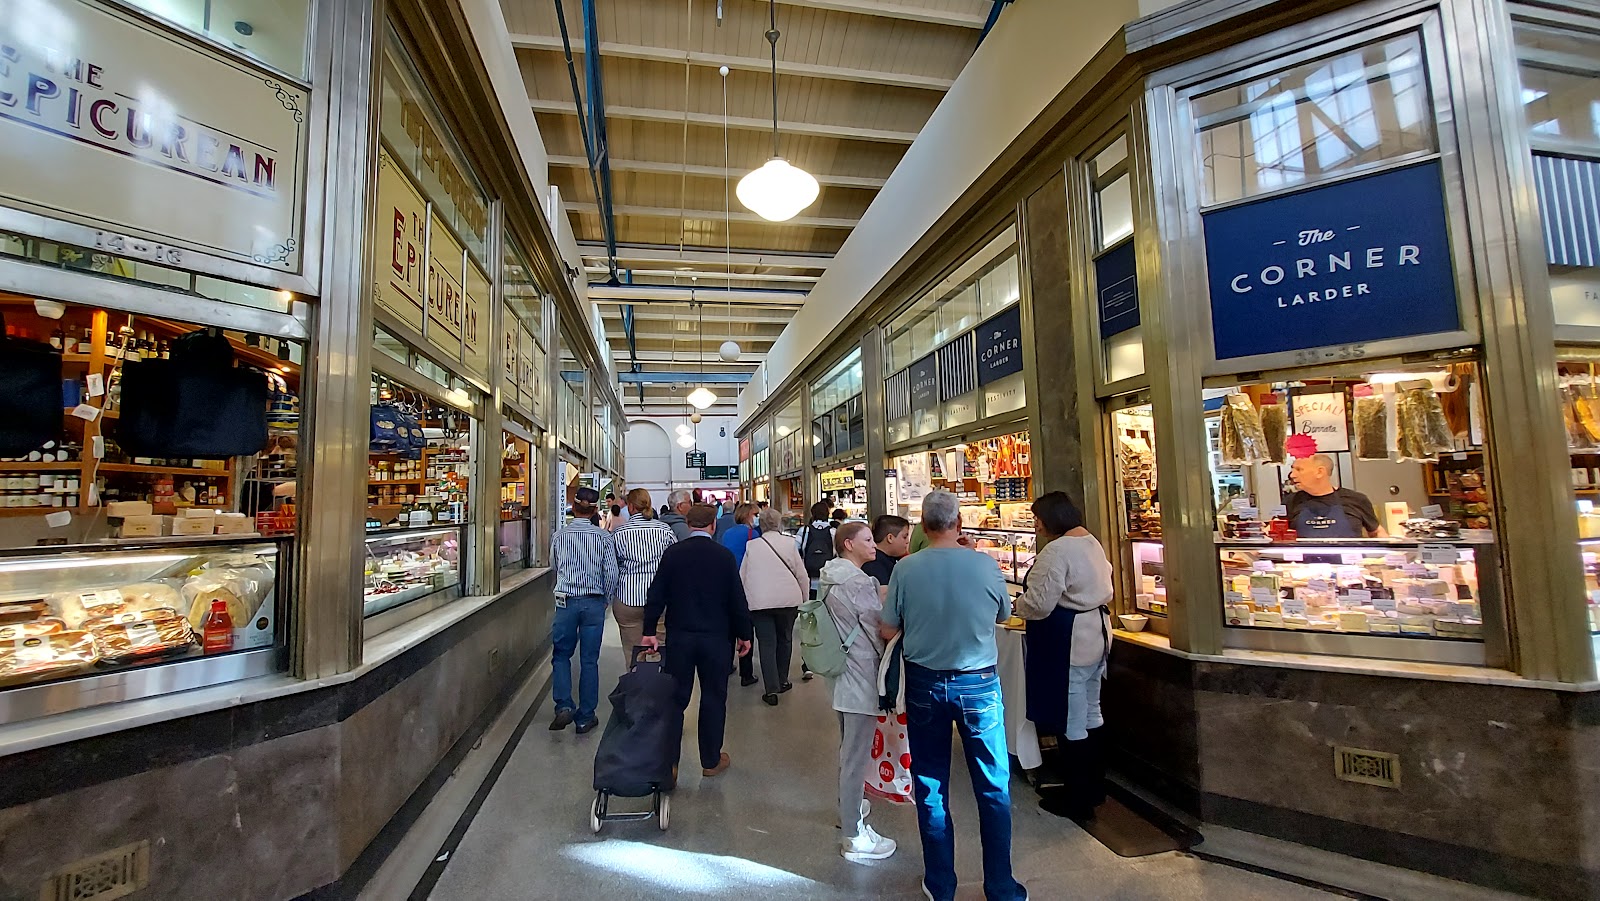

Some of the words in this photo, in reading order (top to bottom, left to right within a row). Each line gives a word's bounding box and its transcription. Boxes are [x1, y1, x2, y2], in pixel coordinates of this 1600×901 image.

[1298, 228, 1336, 247] The
[1230, 244, 1421, 294] CORNER
[1277, 282, 1371, 308] LARDER
[981, 338, 1018, 362] CORNER
[912, 377, 935, 394] CORNER
[1294, 401, 1344, 418] SPECIAL!
